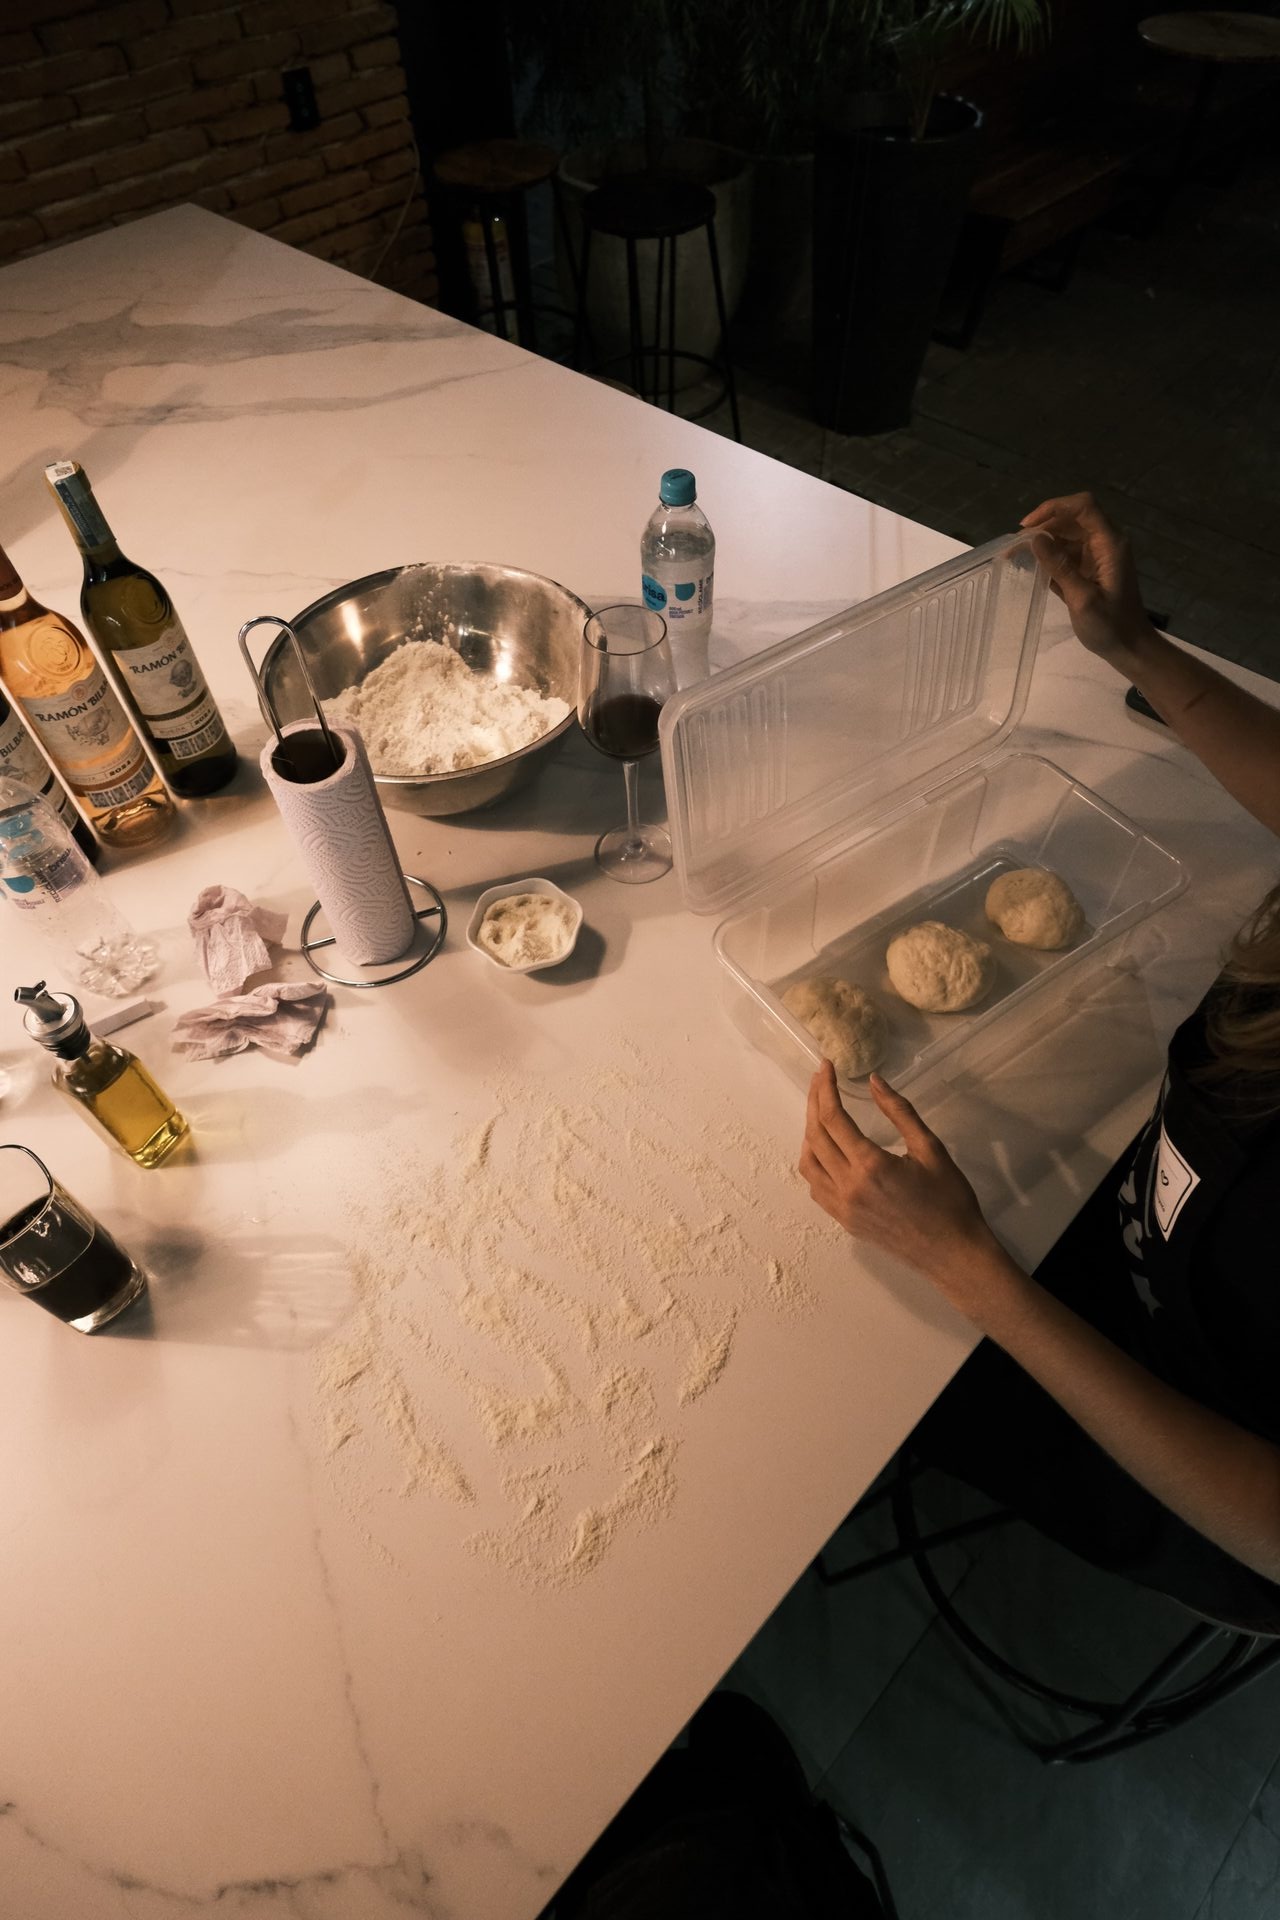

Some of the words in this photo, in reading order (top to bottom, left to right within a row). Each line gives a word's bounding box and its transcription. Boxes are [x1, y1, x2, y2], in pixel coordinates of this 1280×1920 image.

[642, 580, 667, 602] risa
[129, 650, 177, 674] RAMÓN
[35, 702, 88, 722] RAMÓN
